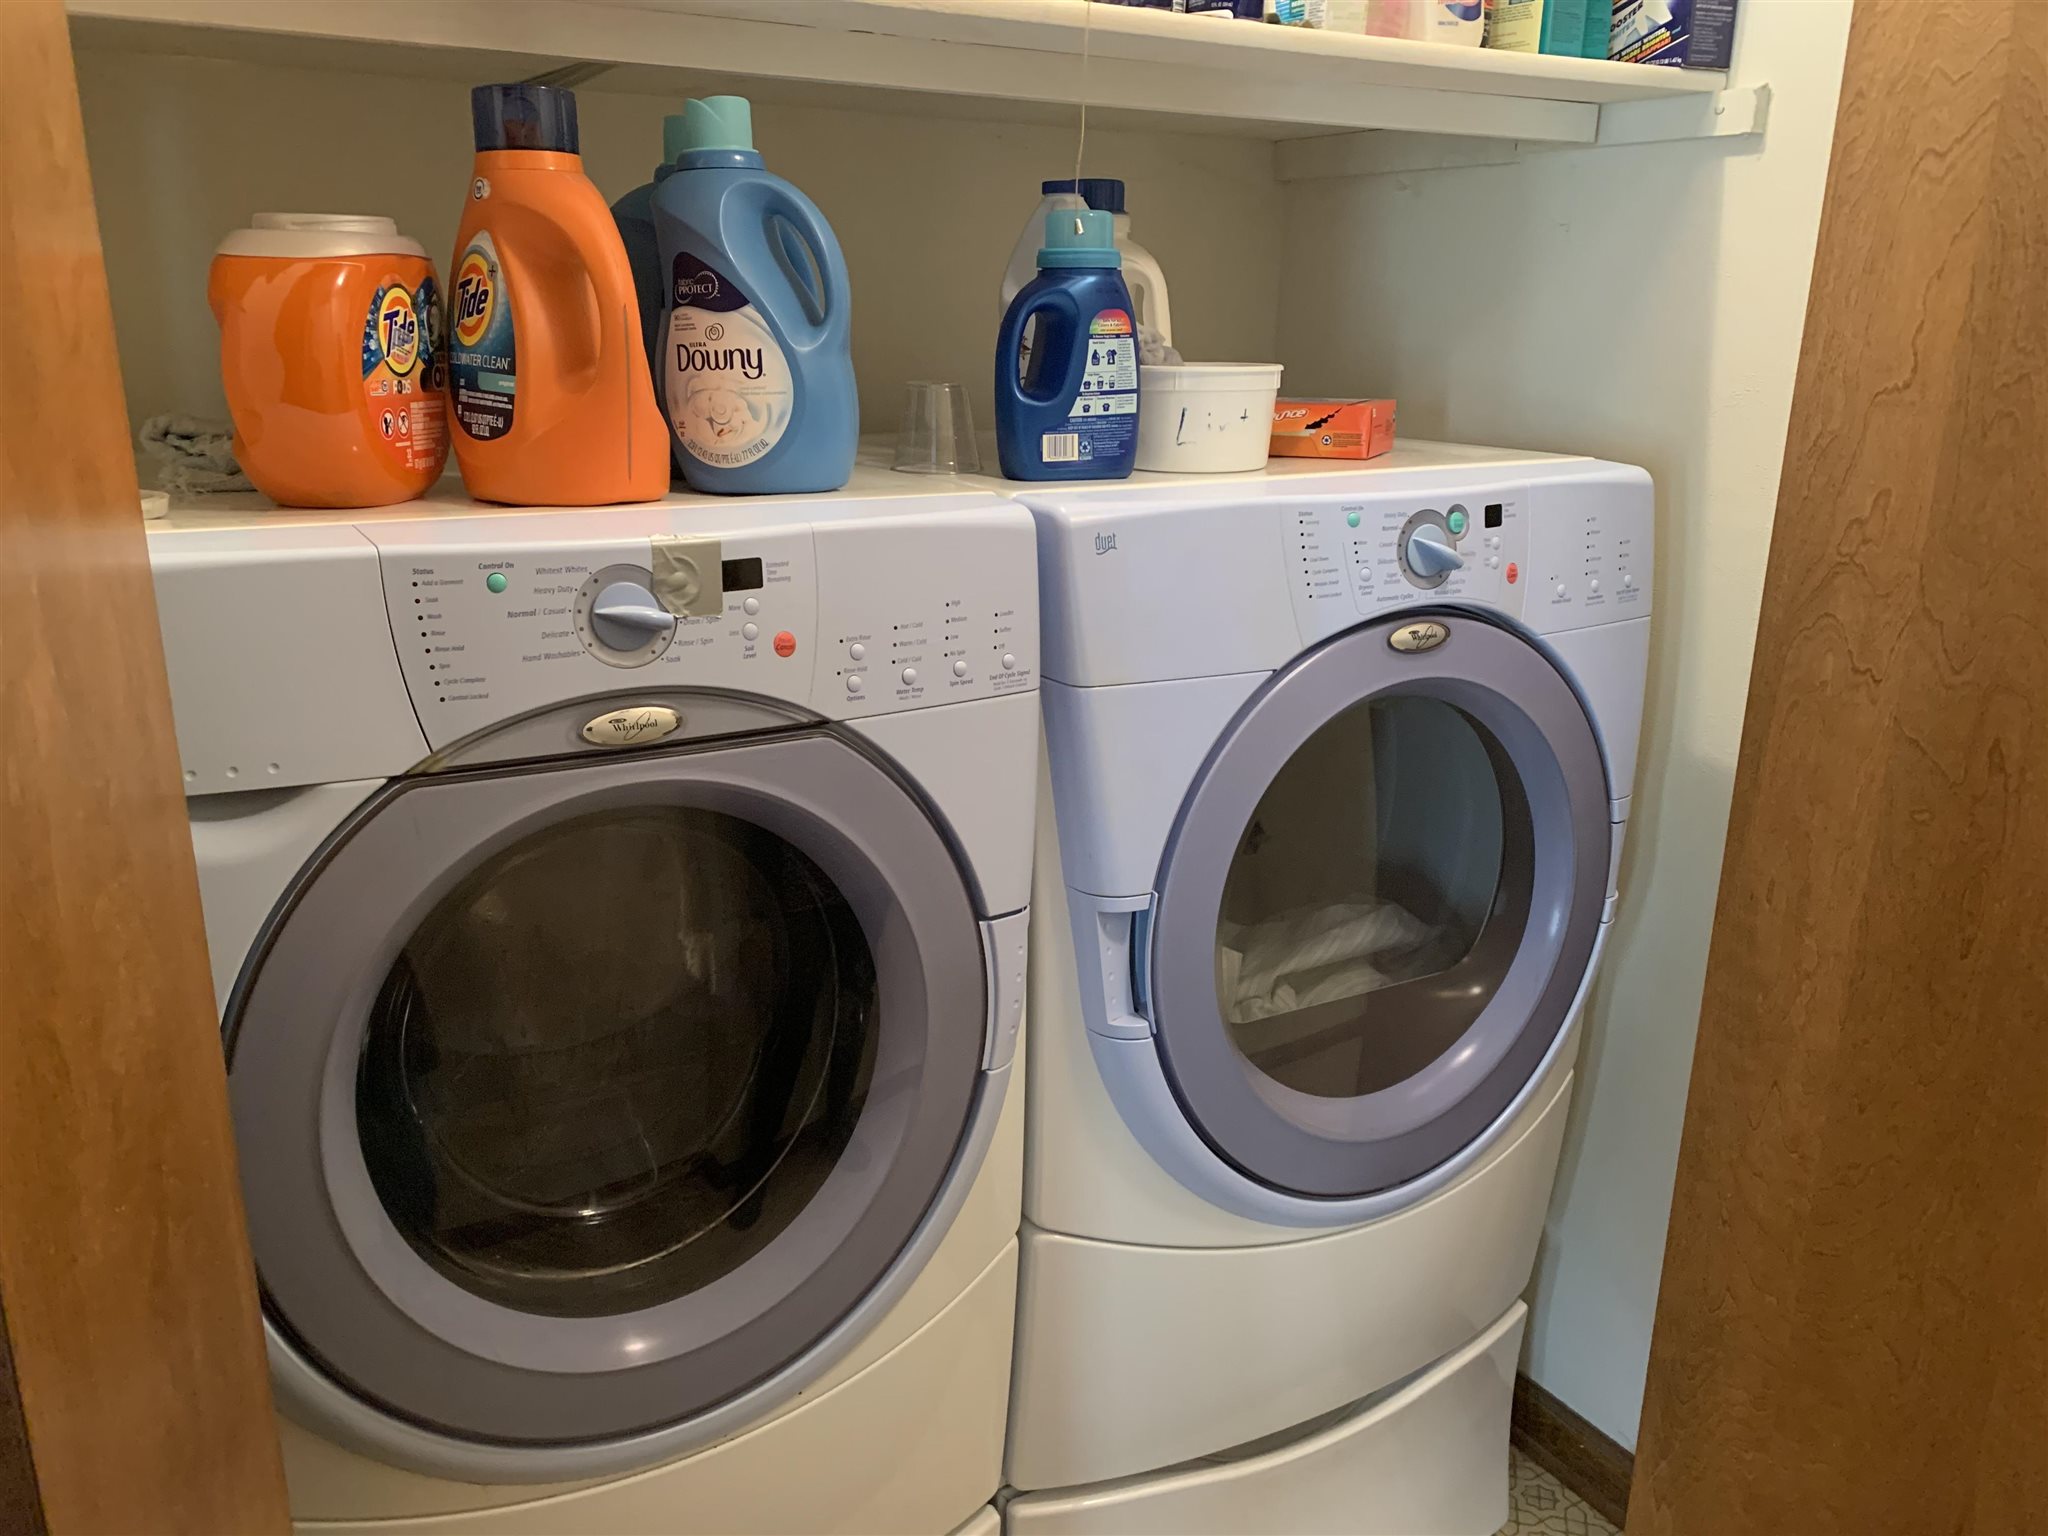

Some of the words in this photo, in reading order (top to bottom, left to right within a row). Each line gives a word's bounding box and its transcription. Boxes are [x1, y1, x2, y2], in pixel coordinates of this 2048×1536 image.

[1609, 2, 1643, 33] OOSTER
[679, 284, 712, 295] PROTECT
[455, 276, 489, 329] Tide
[383, 308, 415, 359] Tide
[676, 344, 763, 379] Downy
[1274, 408, 1307, 421] unce
[478, 562, 503, 570] Control
[536, 567, 563, 576] Whitest
[565, 565, 588, 574] Whites
[533, 587, 556, 595] Heavy
[557, 585, 574, 594] Duty
[507, 609, 536, 618] Normal
[543, 607, 567, 616] Casual
[541, 630, 569, 639] Delicate
[522, 654, 542, 663] Hand
[544, 650, 581, 660] Washables
[743, 652, 757, 660] Level
[612, 719, 658, 733] Whirlpool
